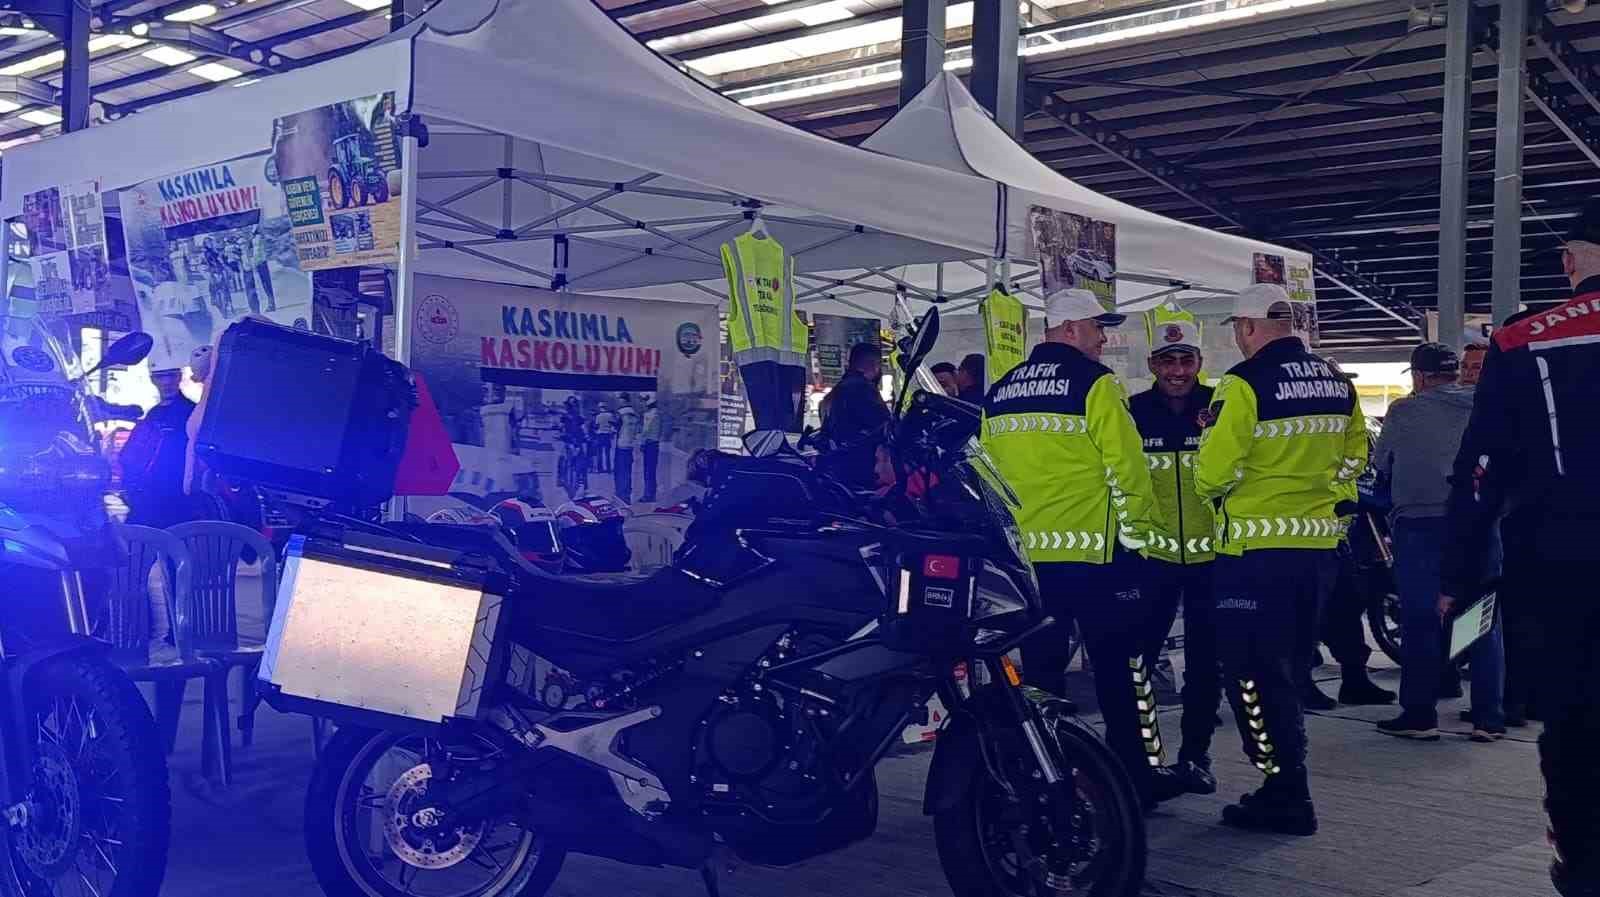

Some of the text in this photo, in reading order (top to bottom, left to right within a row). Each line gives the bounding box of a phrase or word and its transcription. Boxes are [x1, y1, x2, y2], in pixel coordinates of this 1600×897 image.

[157, 165, 236, 202] KASKIMLA
[160, 186, 259, 226] KASKOLUYUM!
[502, 305, 633, 343] KASKIMLA
[480, 336, 661, 375] KASKOLUYUM!
[993, 379, 1070, 403] JANDARMASI
[1275, 380, 1349, 400] JANDARMASI
